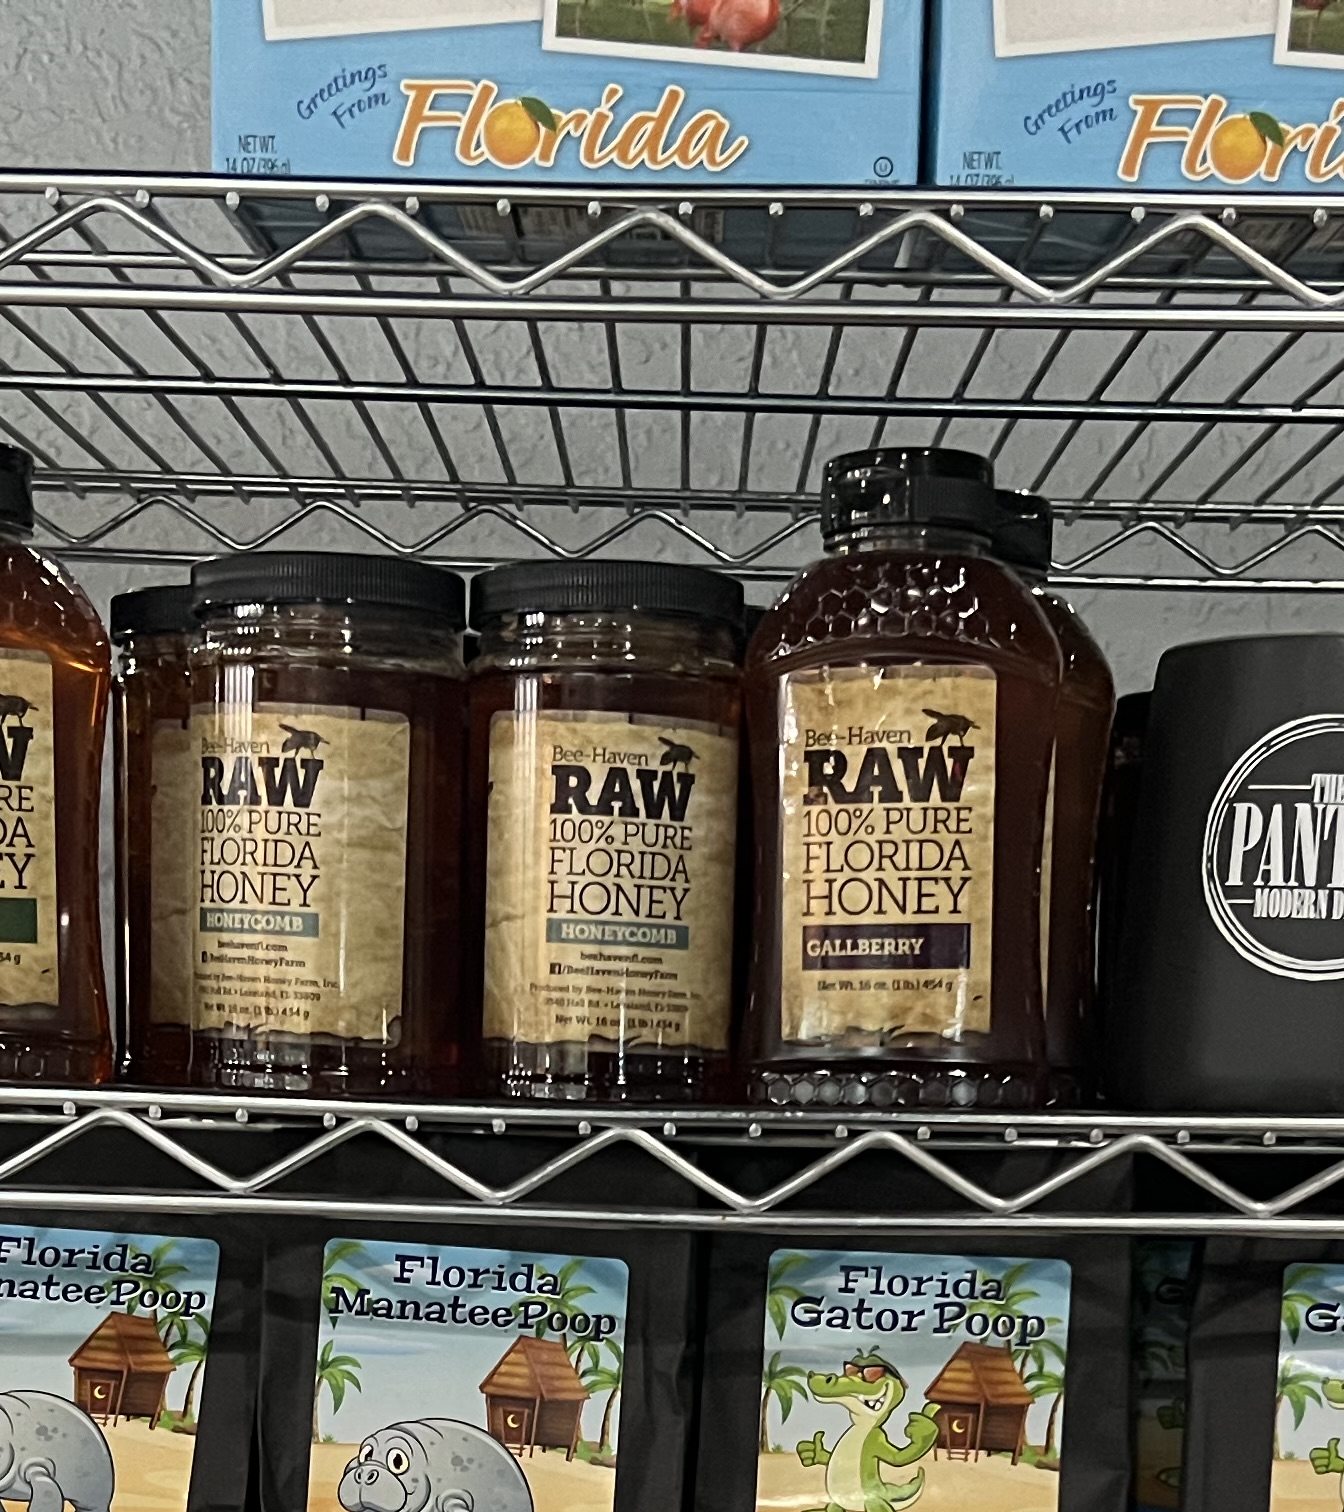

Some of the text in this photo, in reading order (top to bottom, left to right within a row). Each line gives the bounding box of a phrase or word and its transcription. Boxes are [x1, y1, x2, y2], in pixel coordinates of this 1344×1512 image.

[296, 63, 389, 121] Greetings
[331, 89, 392, 129] From
[1023, 79, 1118, 136] Greetings
[238, 134, 258, 154] NET
[393, 80, 748, 169] Florida
[1059, 105, 1118, 146] From
[552, 745, 649, 766] Bee-Haven
[803, 746, 975, 805] RAW
[201, 756, 324, 809] RAW
[550, 764, 696, 822] RAW
[549, 818, 693, 851] 100% PURE
[803, 806, 973, 837] 100% PURE
[200, 836, 320, 870] FLORIDA
[802, 839, 972, 874] FLORIDA
[200, 869, 320, 907] HONEY
[802, 876, 972, 916] HONEY
[1253, 888, 1329, 920] MODERN
[206, 911, 304, 932] HONEYCOMB
[561, 922, 677, 945] HONEYCOMB
[806, 937, 925, 956] GALLBERRY
[392, 1253, 562, 1297] Florida
[837, 1264, 1005, 1302] Florida
[110, 1279, 207, 1320] Poop
[328, 1286, 618, 1343] Manatee Poop
[790, 1295, 1047, 1347] Gator Poop
